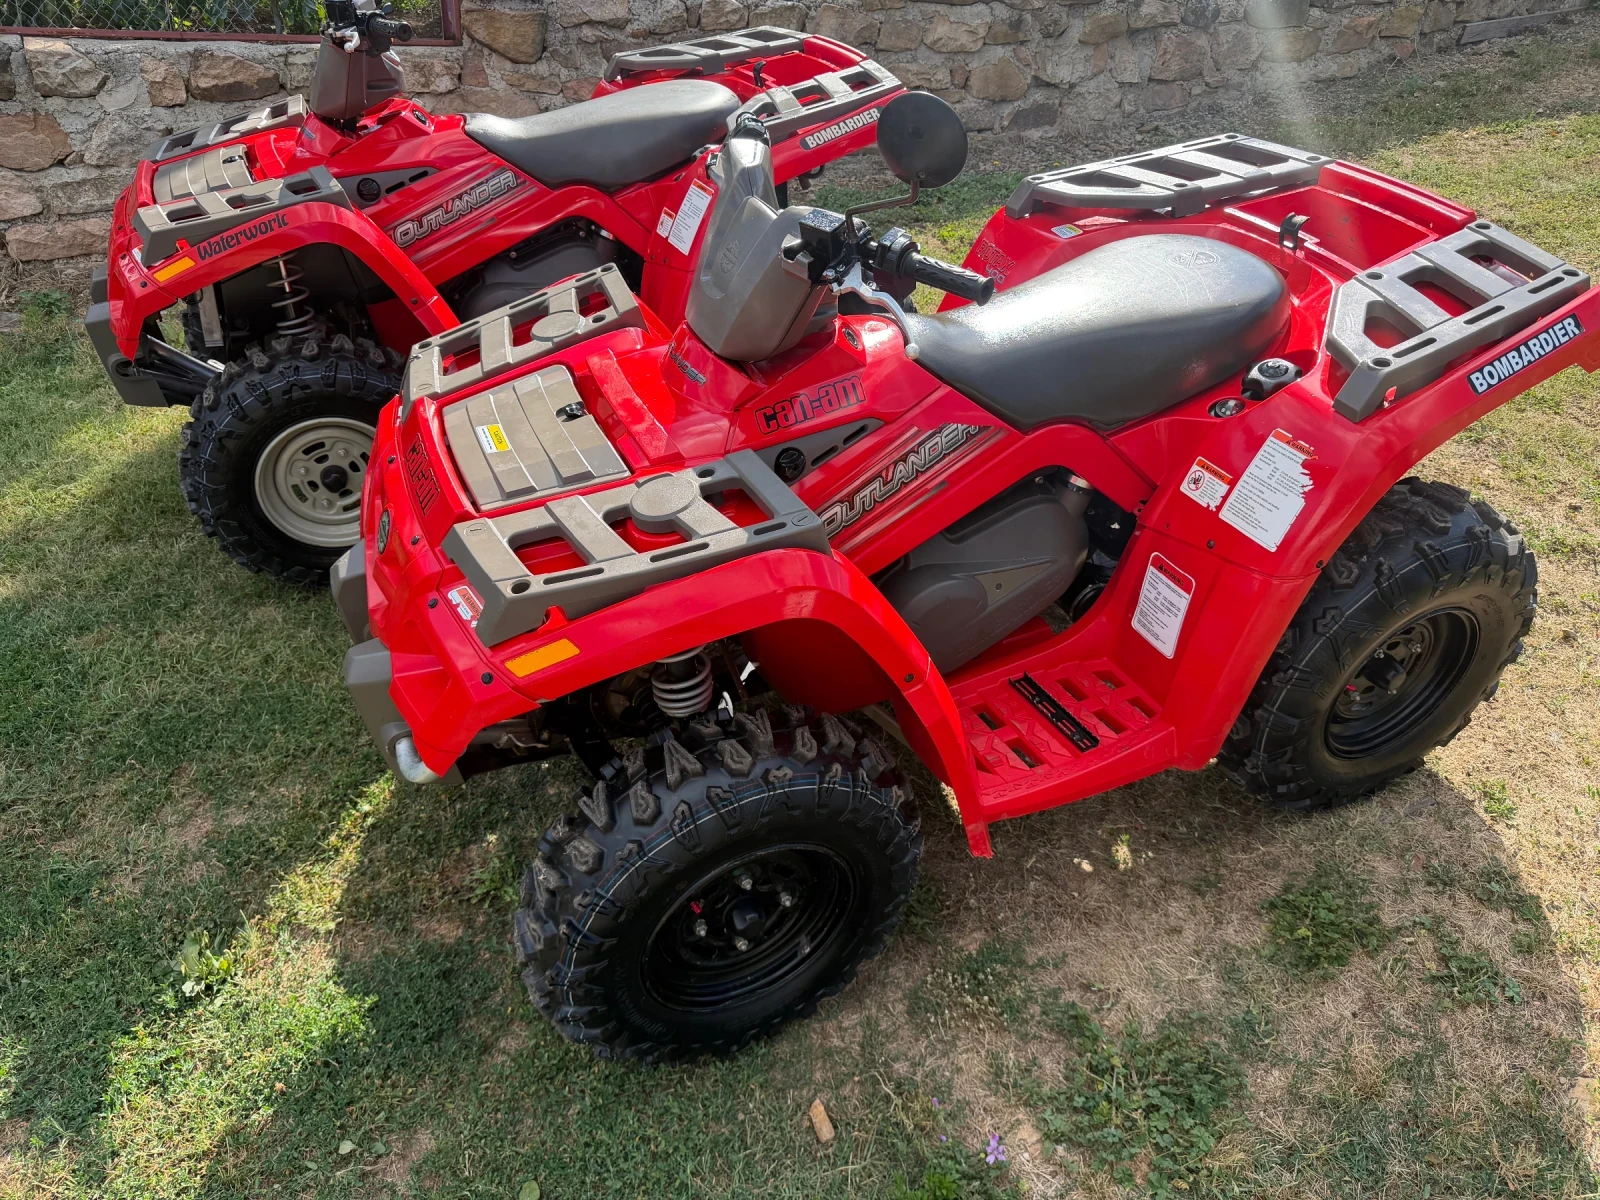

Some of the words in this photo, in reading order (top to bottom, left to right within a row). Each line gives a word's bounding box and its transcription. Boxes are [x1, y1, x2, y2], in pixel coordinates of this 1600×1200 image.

[805, 108, 880, 149] BOMBARDIER
[394, 170, 517, 248] OUTLANDER
[1469, 317, 1580, 393] BOMBARDIER
[755, 375, 867, 436] can-am
[1291, 440, 1315, 458] WARNING
[1163, 568, 1185, 586] WARNING
